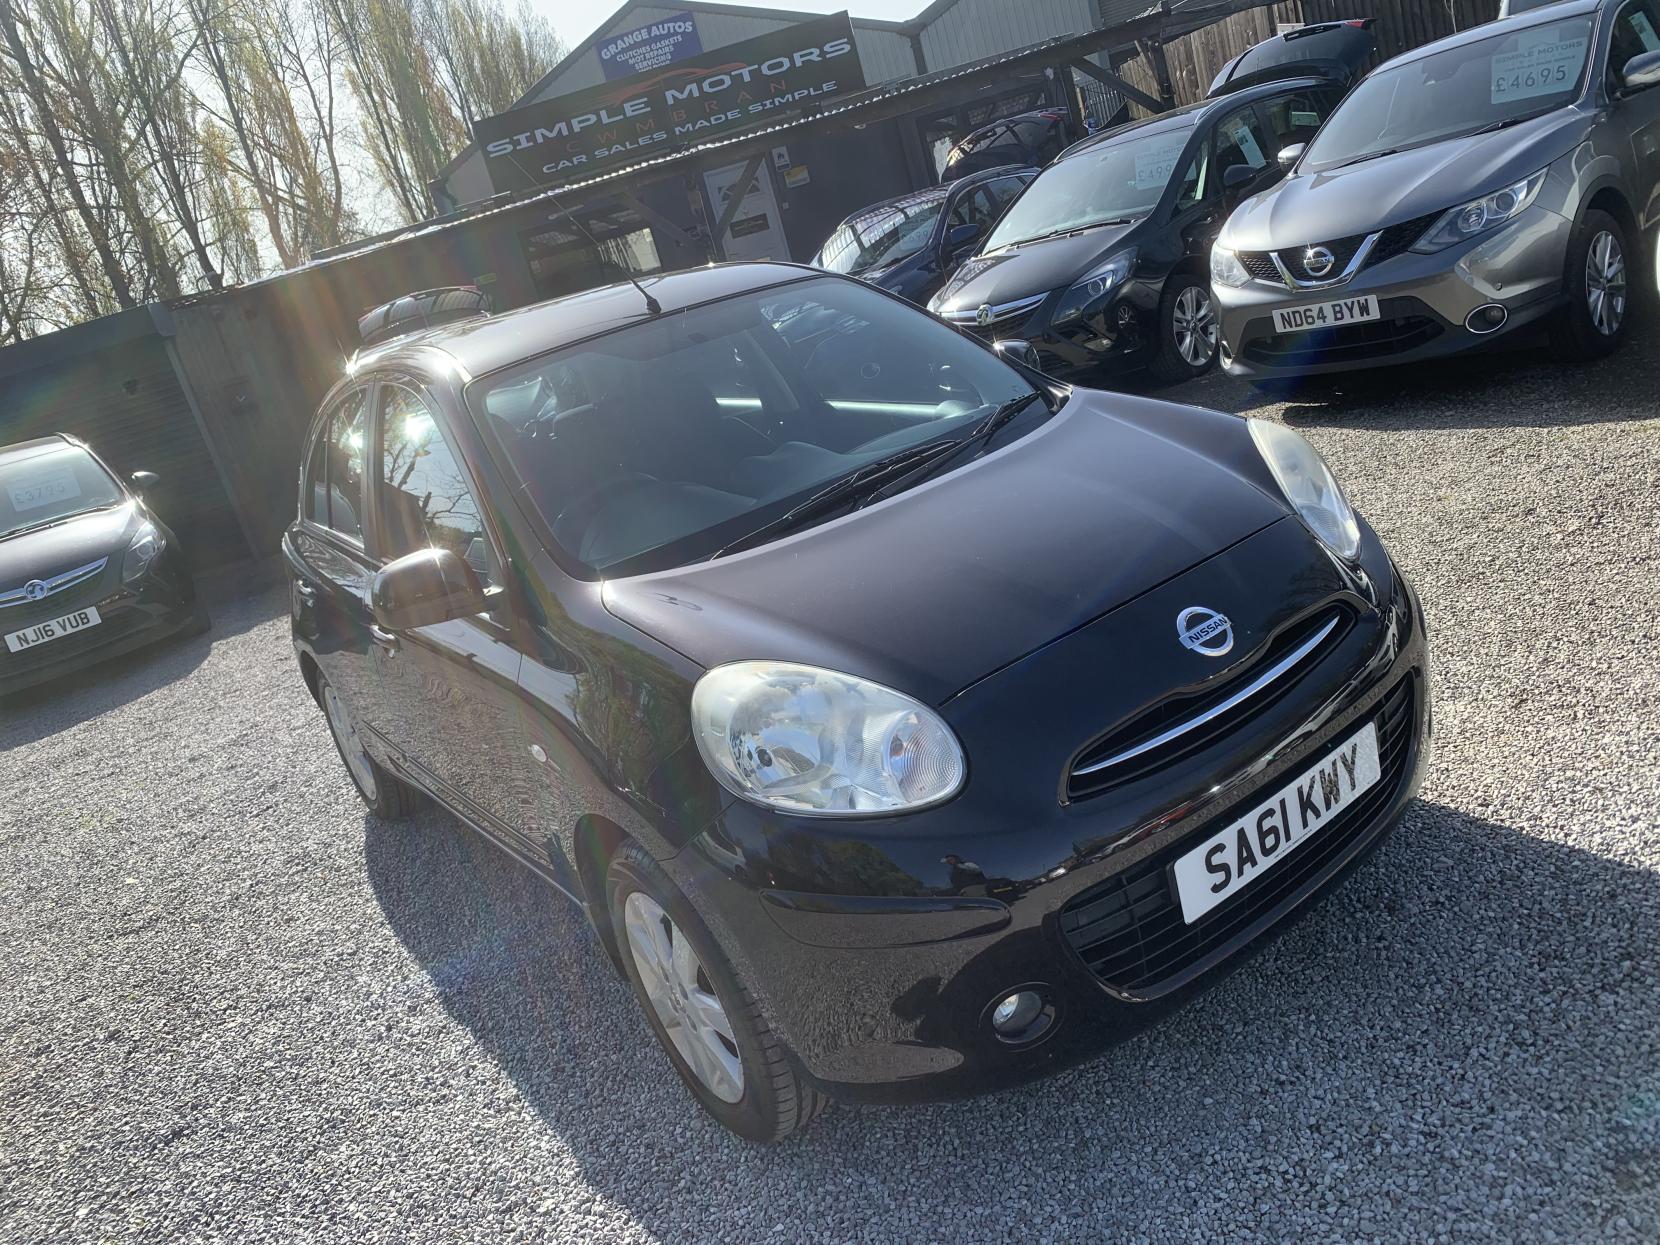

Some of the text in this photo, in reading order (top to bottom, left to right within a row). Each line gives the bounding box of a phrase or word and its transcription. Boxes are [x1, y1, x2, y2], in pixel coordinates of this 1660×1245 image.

[601, 21, 693, 59] GRANGE AUTOS
[616, 34, 683, 62] CLUTCHES GASKETS
[628, 45, 674, 65] MOT REPAIRS
[634, 53, 672, 70] SERVICING
[1495, 65, 1566, 93] £4695
[486, 38, 851, 158] SIMPLE MOTORS
[542, 80, 838, 174] CAR SALES MADE SIMPLE
[1138, 164, 1173, 181] £499
[1280, 298, 1371, 330] ND64 BYW
[16, 611, 91, 648] NJ16 VUB
[1187, 616, 1228, 644] NISSAN
[1204, 742, 1359, 894] SA61 KWY
